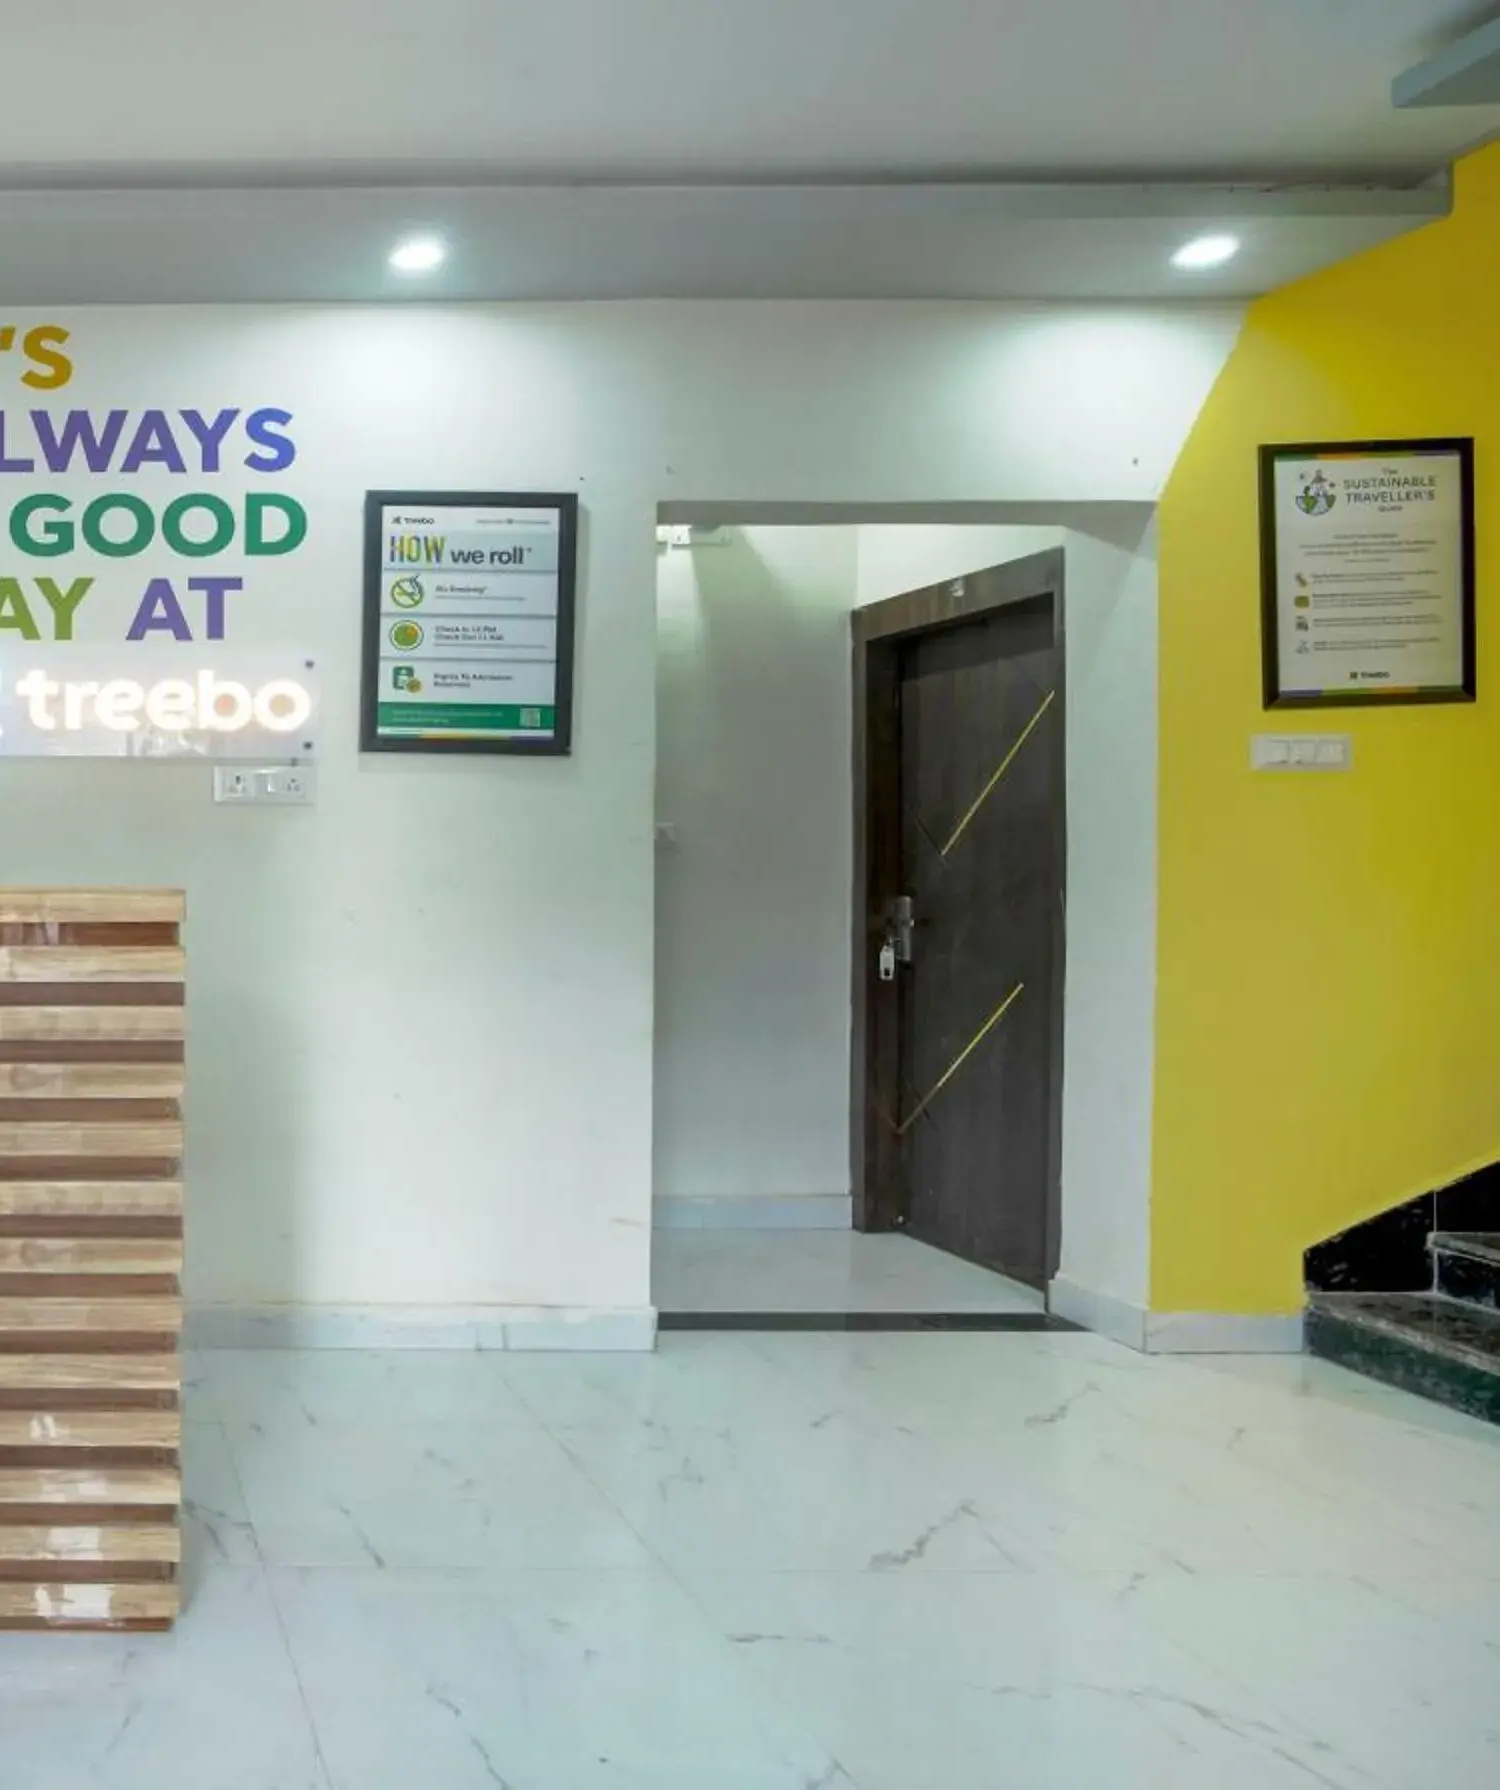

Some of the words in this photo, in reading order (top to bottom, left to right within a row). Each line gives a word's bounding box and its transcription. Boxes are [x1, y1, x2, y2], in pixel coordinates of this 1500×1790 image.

[1343, 475, 1437, 489] SUSTAINABLE
[9, 492, 308, 558] GOOD
[390, 535, 446, 563] HOW
[451, 549, 484, 564] we
[125, 577, 243, 641] AT
[15, 668, 313, 732] treebo
